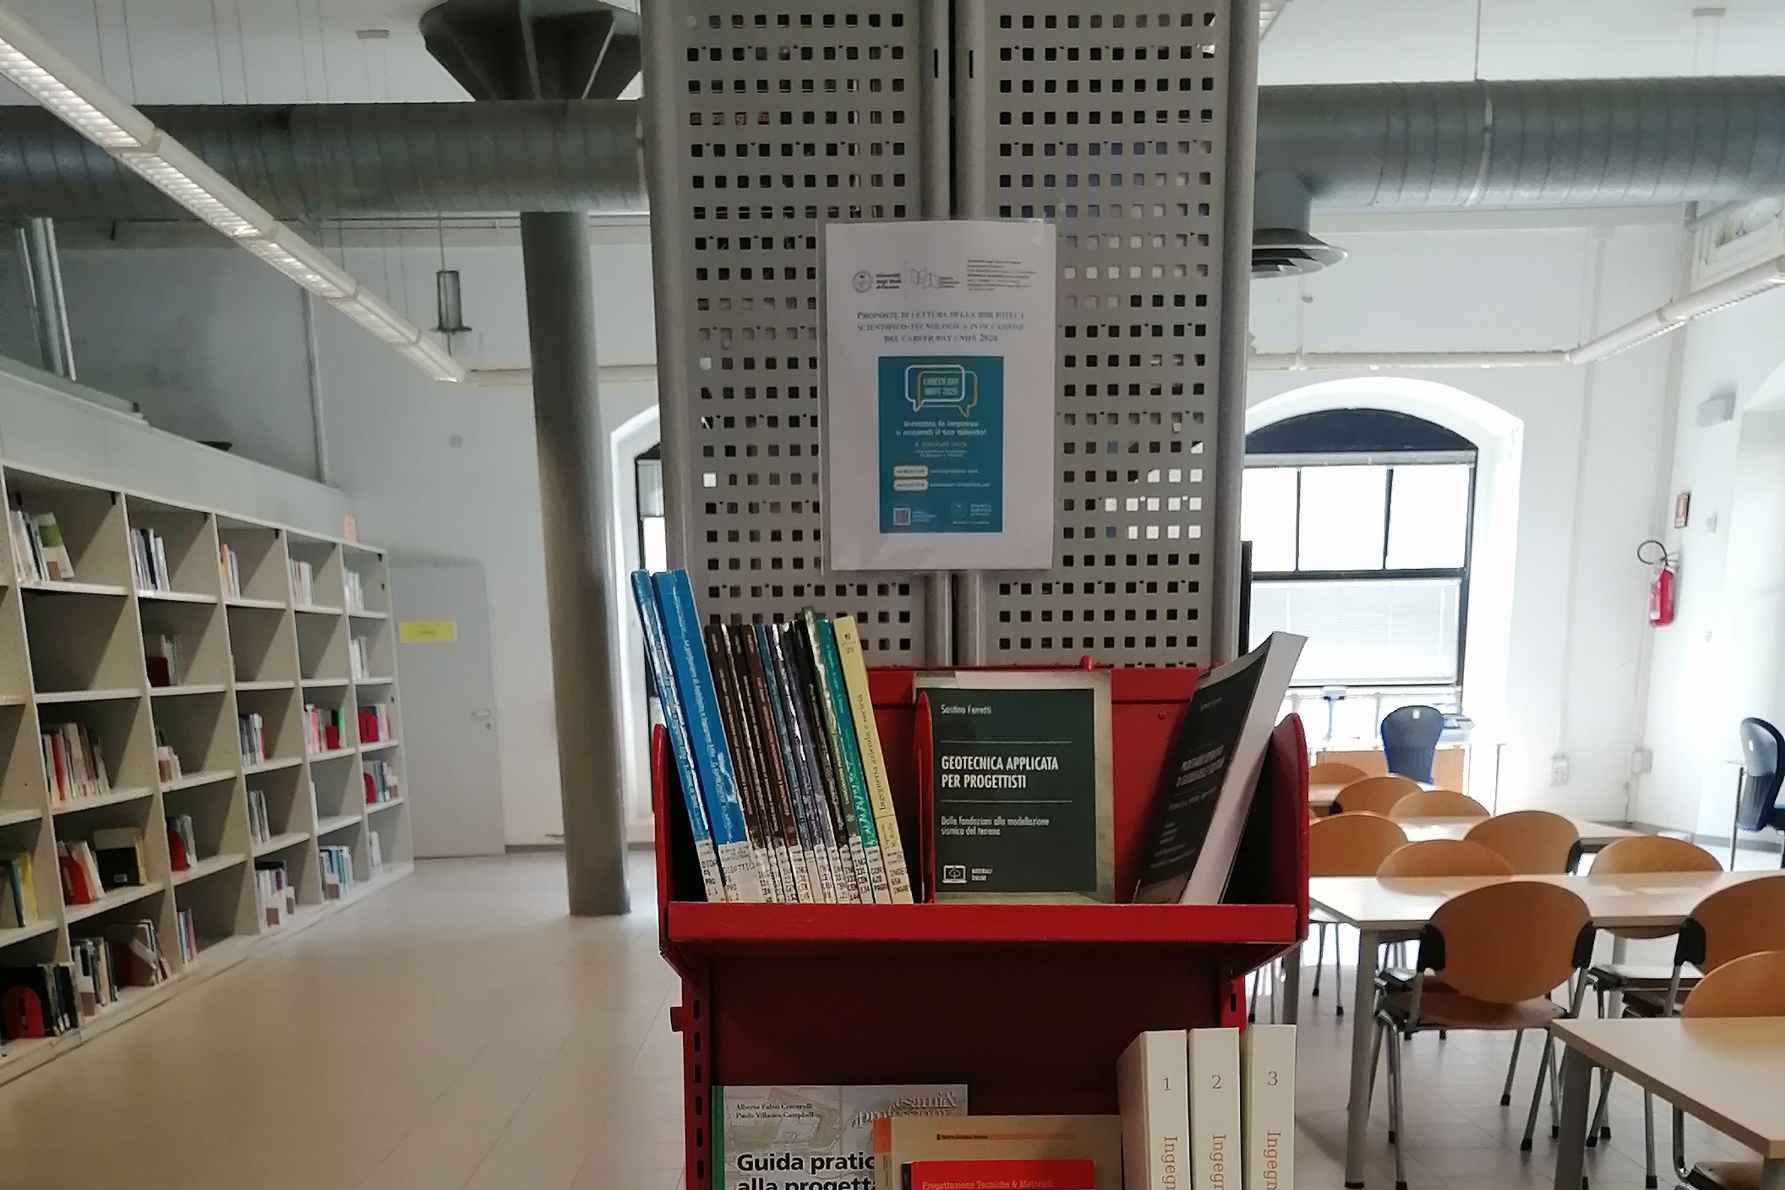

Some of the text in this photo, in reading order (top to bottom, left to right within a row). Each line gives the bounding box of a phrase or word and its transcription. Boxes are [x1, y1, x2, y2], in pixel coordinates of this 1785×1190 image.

[941, 756, 1059, 771] GEOTECNICA APPLICATA
[941, 774, 1026, 788] PER PROGETTISTI
[1162, 1077, 1172, 1091] 1
[1211, 1075, 1222, 1090] 2
[1267, 1071, 1278, 1086] 3
[737, 1152, 875, 1175] Guida pratic
